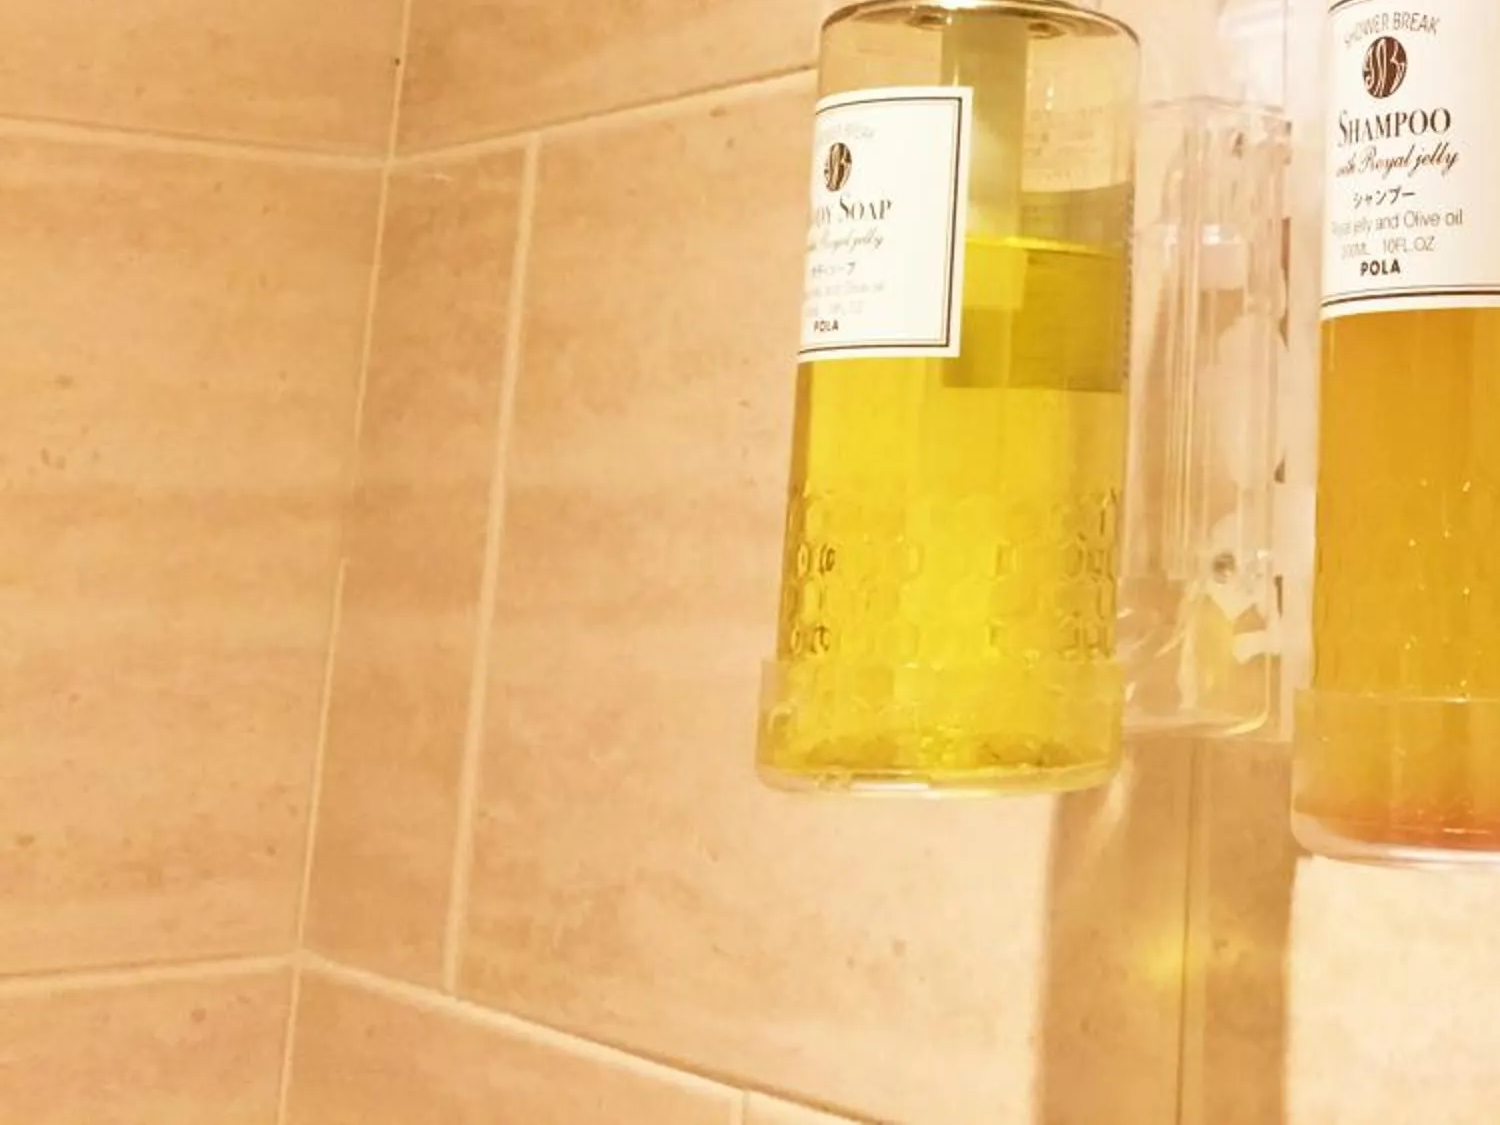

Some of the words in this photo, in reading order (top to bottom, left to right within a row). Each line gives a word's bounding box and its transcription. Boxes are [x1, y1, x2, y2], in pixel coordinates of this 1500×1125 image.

[1393, 11, 1440, 35] BREAK
[1337, 107, 1451, 147] SHAMPOO
[1358, 143, 1415, 179] Royal
[1407, 141, 1459, 178] jelly
[838, 192, 893, 223] SOAP
[1376, 214, 1399, 231] and
[1403, 210, 1440, 228] Olive
[1445, 207, 1463, 226] oil
[1360, 258, 1400, 277] POLA
[814, 319, 839, 333] POLA
